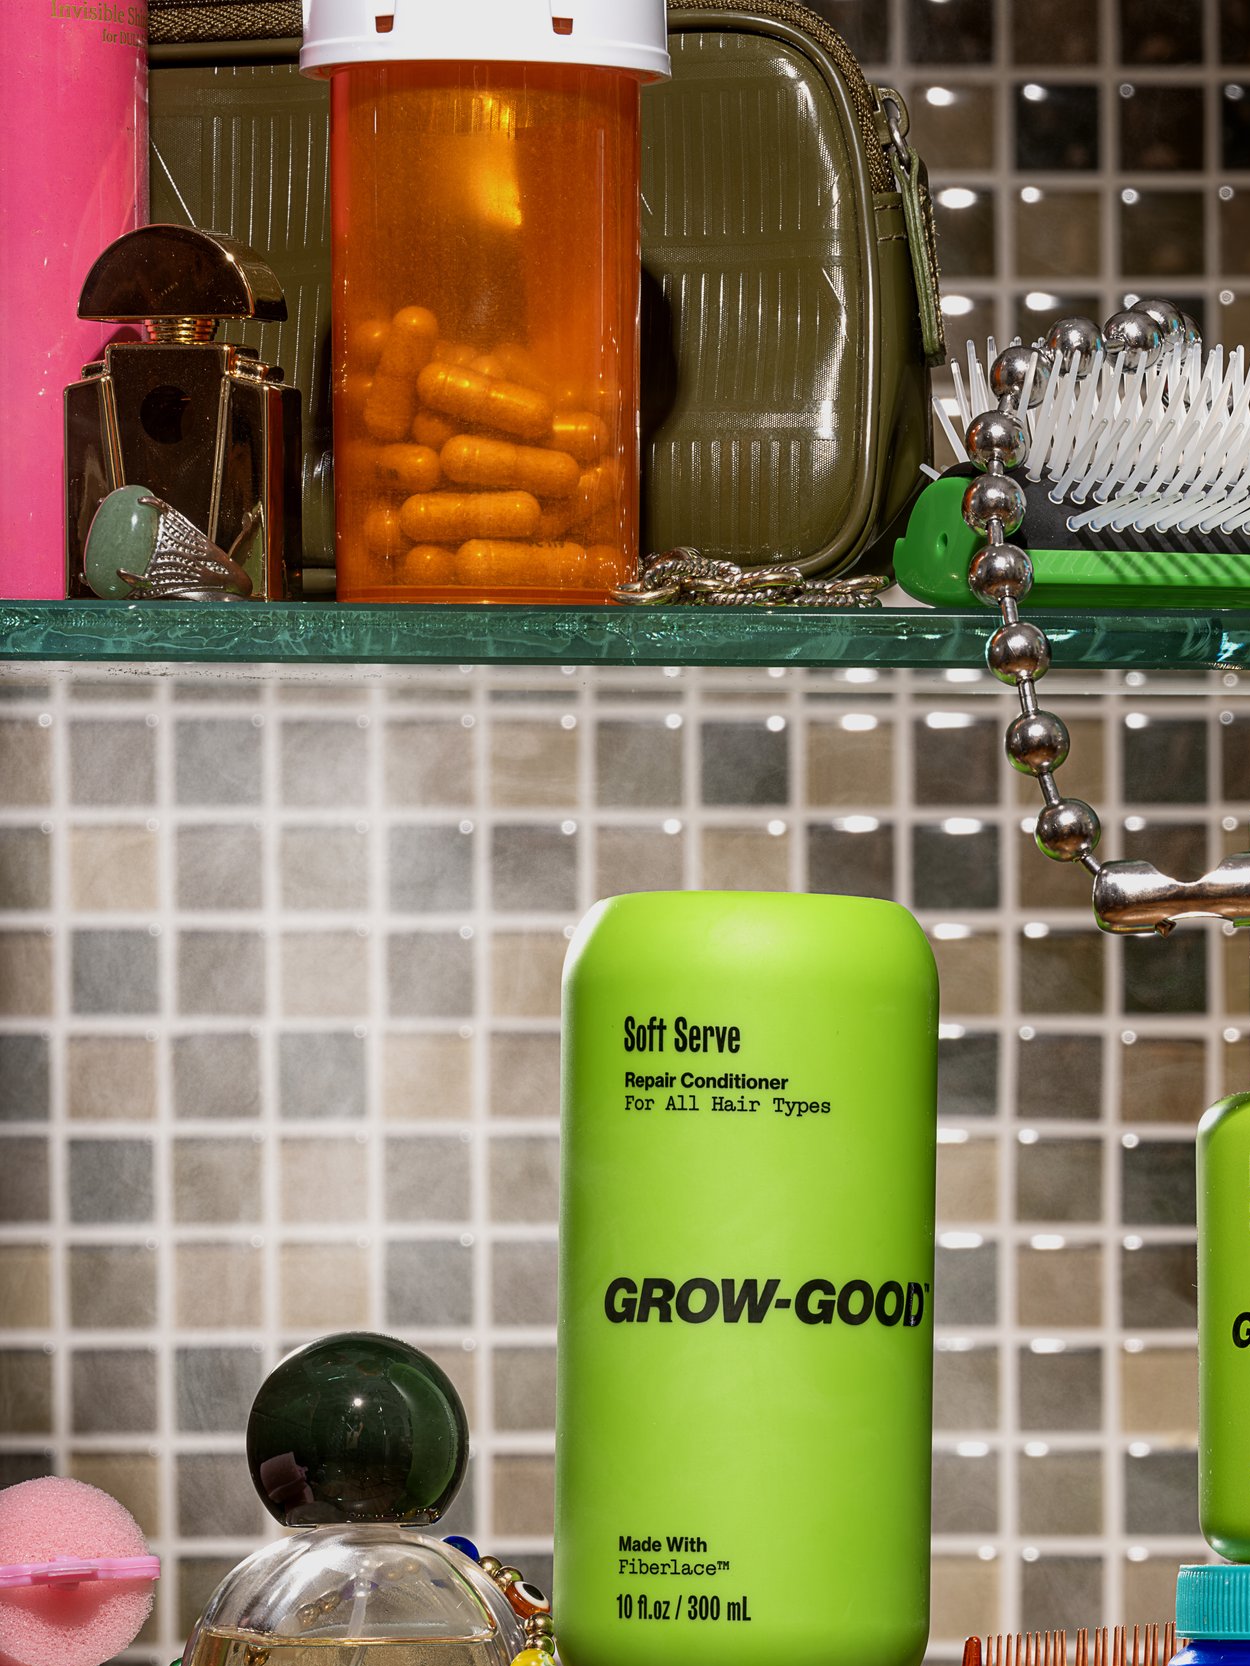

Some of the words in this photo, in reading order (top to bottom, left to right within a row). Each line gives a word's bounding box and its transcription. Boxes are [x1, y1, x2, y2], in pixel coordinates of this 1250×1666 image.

[51, 0, 124, 23] Invisible
[103, 29, 118, 43] for
[623, 1015, 667, 1053] Soft
[674, 1016, 741, 1054] Serve
[624, 1071, 677, 1091] Repair
[680, 1071, 789, 1091] Conditioner
[624, 1095, 655, 1111] For
[664, 1094, 700, 1111] All
[711, 1095, 761, 1112] Hair
[772, 1097, 831, 1117] Types
[618, 1535, 662, 1553] Made
[665, 1536, 708, 1553] With
[616, 1593, 633, 1619] 10
[637, 1594, 671, 1620] fl.oz
[674, 1594, 683, 1620] /
[687, 1595, 721, 1621] 300
[726, 1595, 752, 1622] mL
